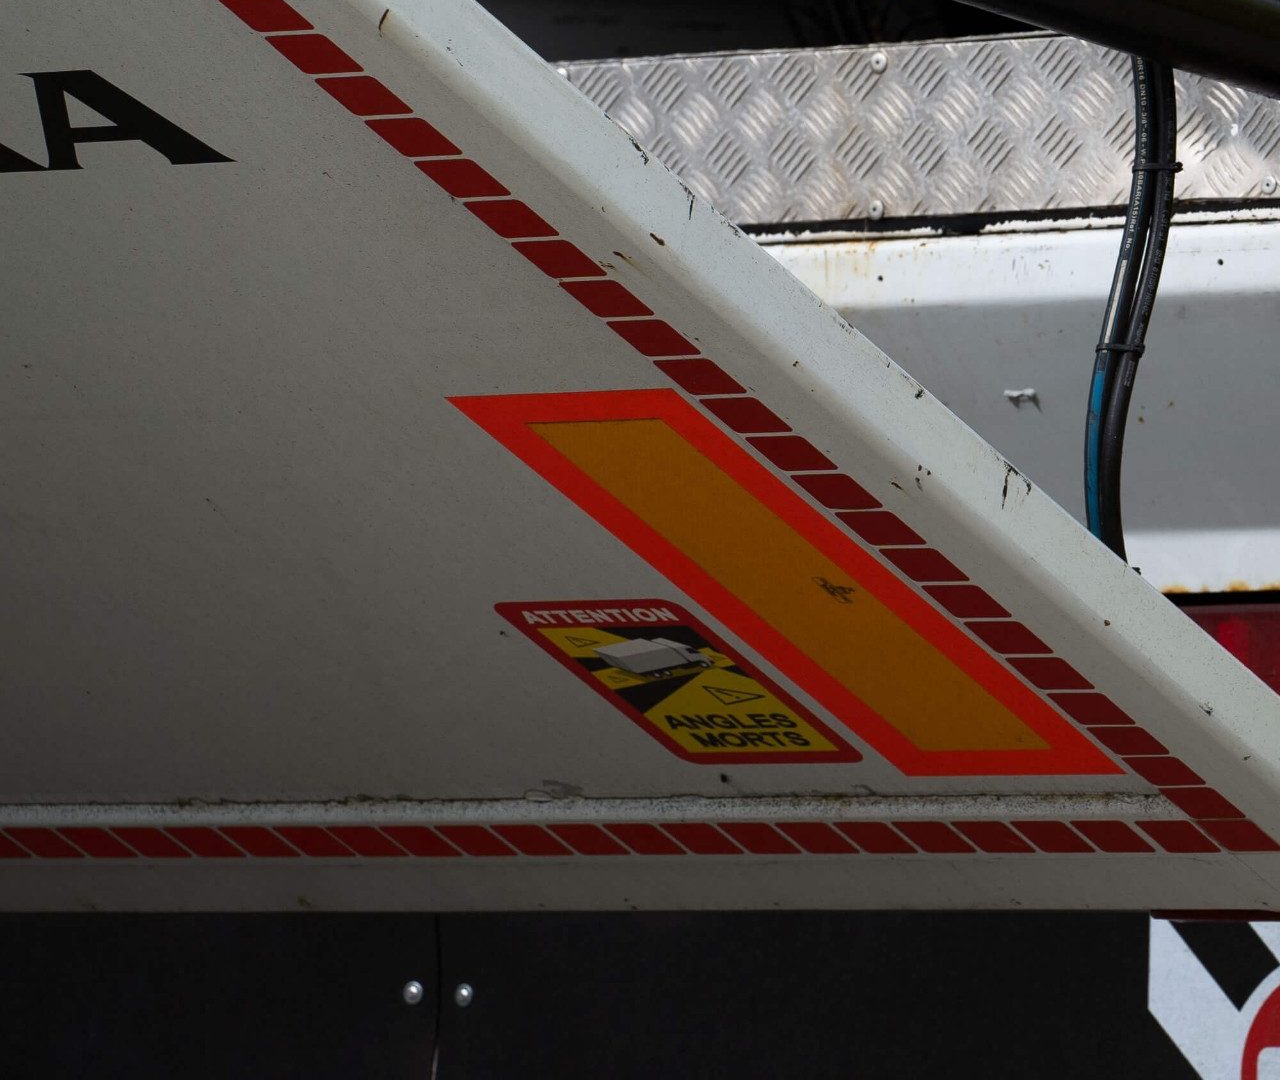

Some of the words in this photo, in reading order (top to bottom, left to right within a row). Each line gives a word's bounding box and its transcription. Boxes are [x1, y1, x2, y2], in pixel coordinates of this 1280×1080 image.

[0, 69, 238, 173] A
[521, 607, 680, 625] ATTENTION
[664, 713, 798, 730] ANGLES
[690, 731, 812, 748] MORTS
